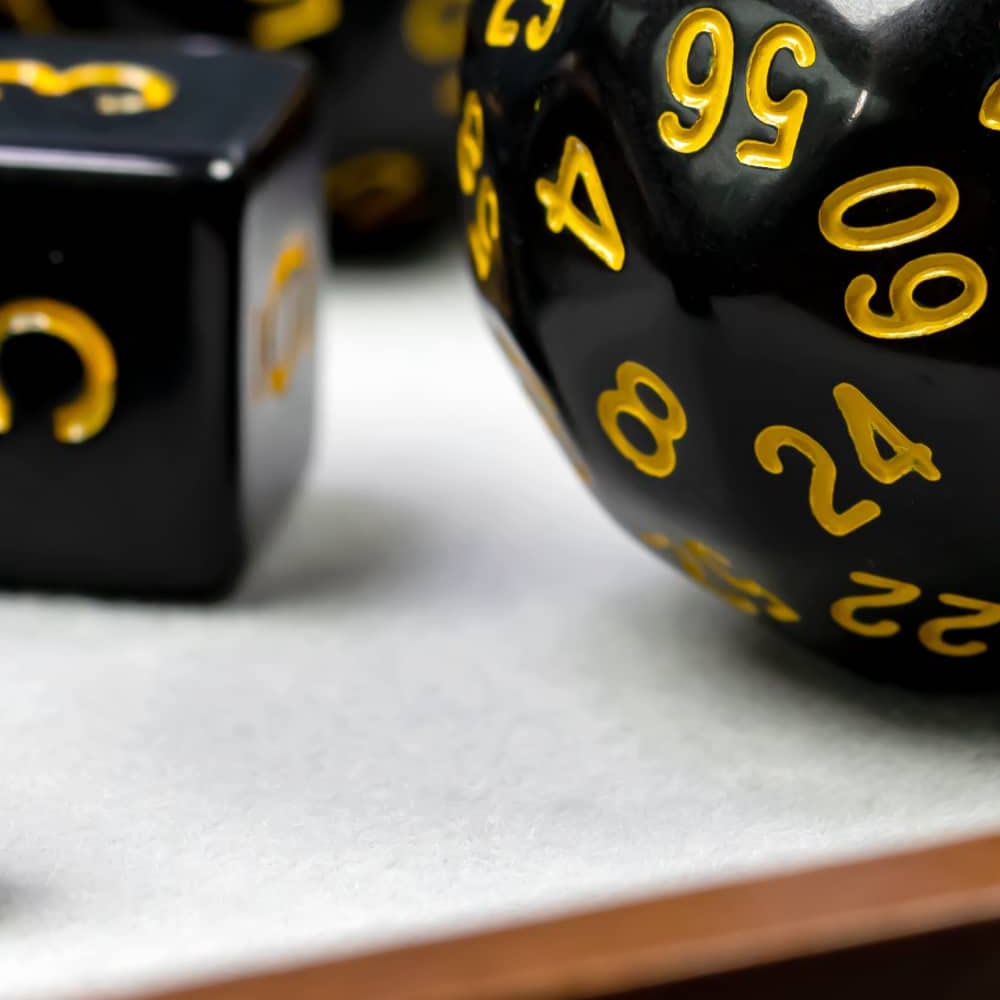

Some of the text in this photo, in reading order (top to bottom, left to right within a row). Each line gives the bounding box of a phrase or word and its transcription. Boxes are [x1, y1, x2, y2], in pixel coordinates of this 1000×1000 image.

[656, 7, 818, 170] 56
[534, 135, 626, 272] 4
[818, 165, 989, 340] 60
[597, 360, 688, 479] 8
[754, 381, 942, 537] 24
